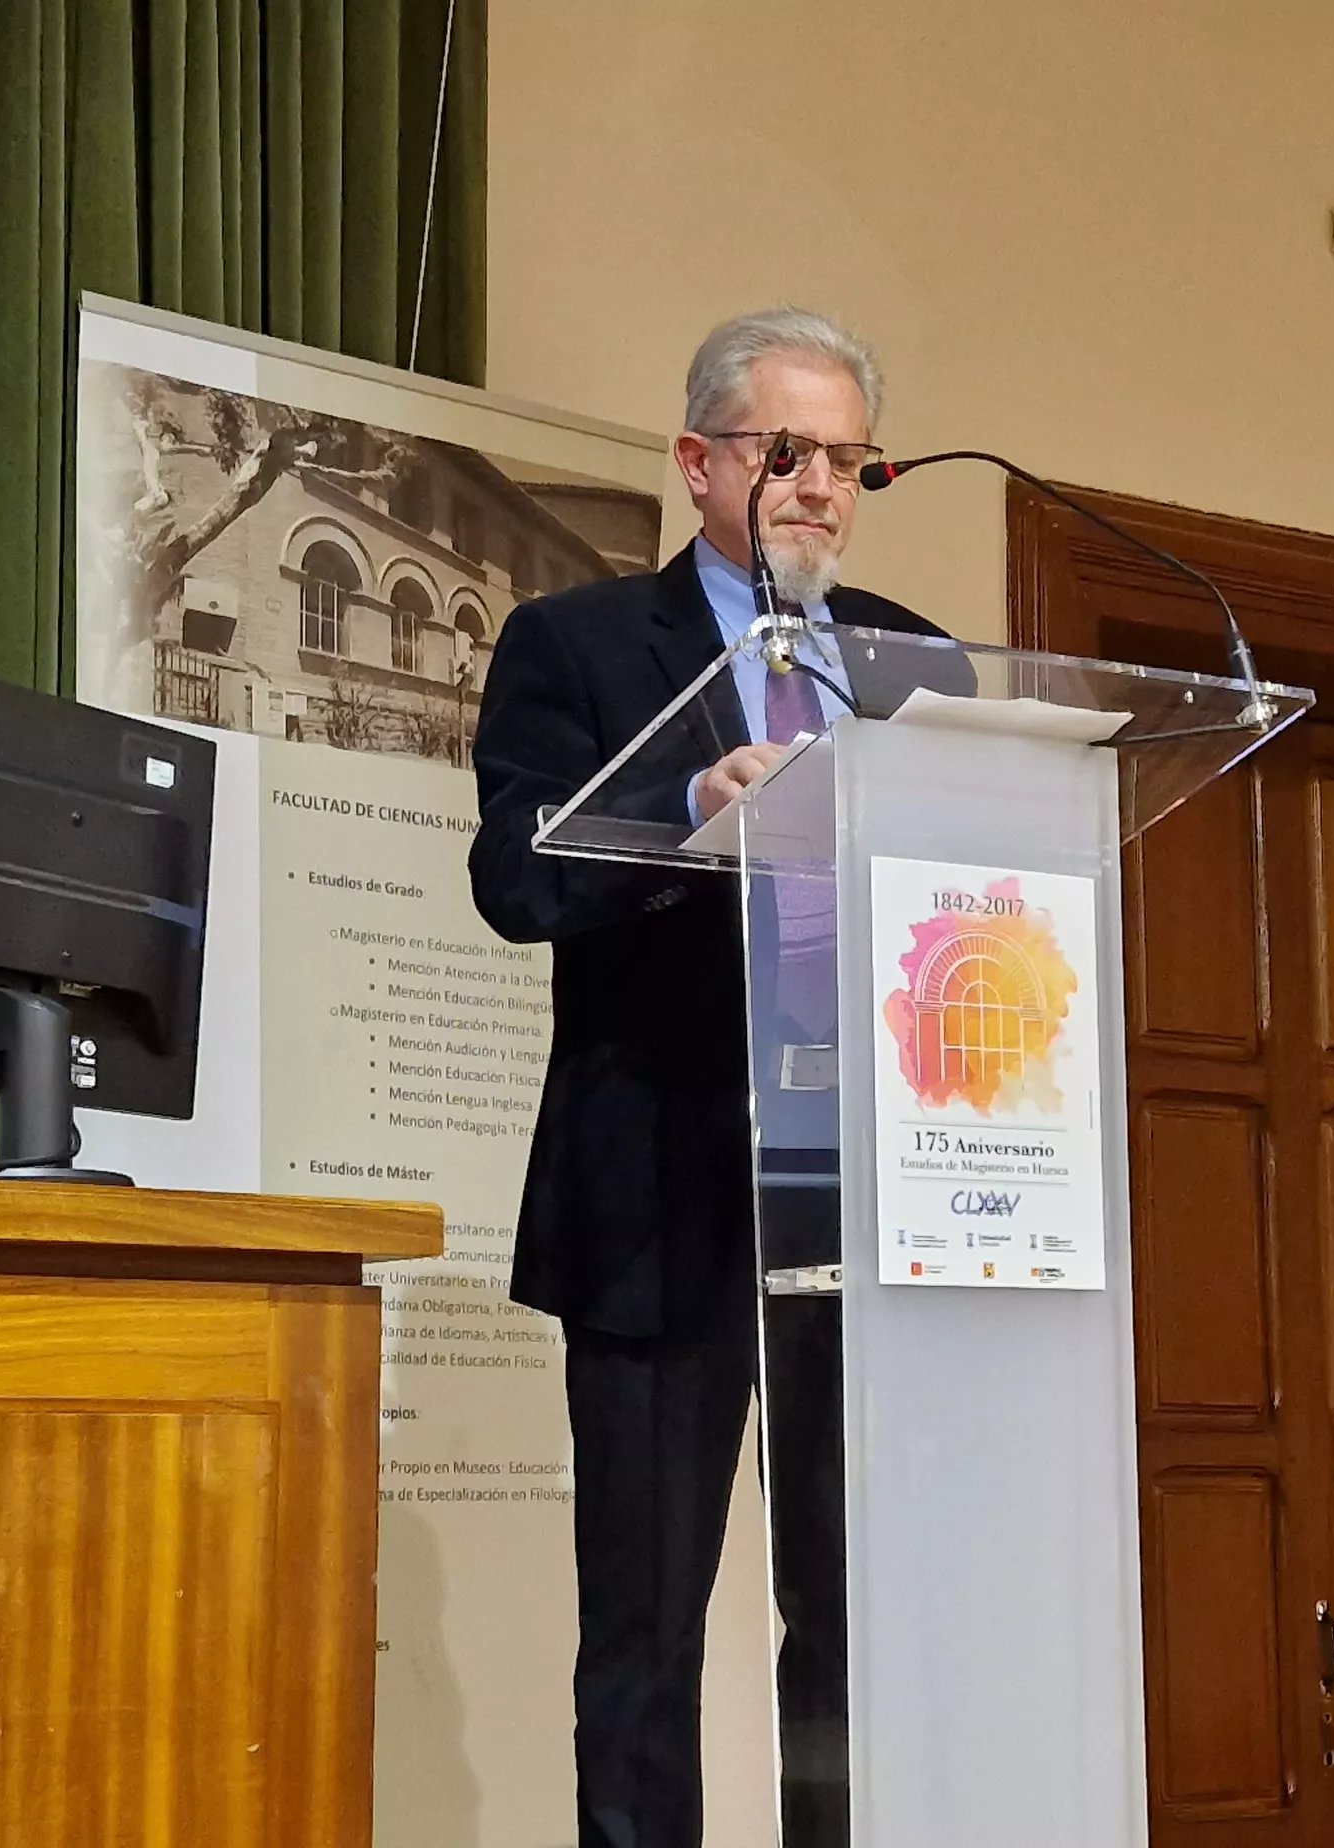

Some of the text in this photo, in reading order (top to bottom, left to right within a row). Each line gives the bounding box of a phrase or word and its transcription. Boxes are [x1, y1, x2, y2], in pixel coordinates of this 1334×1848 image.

[272, 790, 351, 814] FACULTAD
[355, 802, 374, 818] DE
[379, 806, 442, 828] CIENCIAS
[308, 871, 362, 890] Estudios
[366, 879, 382, 892] de
[932, 891, 1025, 917] 1842-2017
[340, 927, 406, 947] Magisterio
[409, 939, 424, 949] en
[428, 938, 487, 957] Educación
[387, 958, 440, 976] Mención
[444, 963, 496, 983] Atención
[499, 976, 507, 985] a
[510, 974, 520, 986] la
[388, 984, 440, 1002] Mención
[444, 990, 504, 1009] Educación
[340, 1004, 406, 1023] Magisterio
[410, 1015, 424, 1026] en
[428, 1014, 488, 1033] Educación
[389, 1035, 442, 1053] Mención
[445, 1040, 496, 1059] Audición
[499, 1049, 507, 1061] y
[389, 1061, 442, 1079] Mención
[446, 1066, 506, 1085] Educación
[389, 1087, 442, 1104] Mención
[446, 1092, 488, 1109] Lengua
[389, 1112, 443, 1130] Mención
[914, 1131, 1055, 1158] 175 Aniversario
[309, 1159, 364, 1179] Estudios
[368, 1163, 383, 1178] de
[900, 1157, 1069, 1176] Estudios de Magisterio en Huesca
[498, 1226, 513, 1238] en
[389, 1272, 468, 1288] Universitario
[472, 1278, 487, 1289] en
[419, 1327, 435, 1340] de
[431, 1353, 446, 1366] de
[450, 1353, 511, 1368] Educación
[390, 1460, 431, 1476] Propio
[434, 1462, 449, 1474] en
[509, 1460, 568, 1475] Educación
[398, 1488, 413, 1502] de
[417, 1488, 508, 1504] Especialización
[511, 1490, 527, 1501] en
